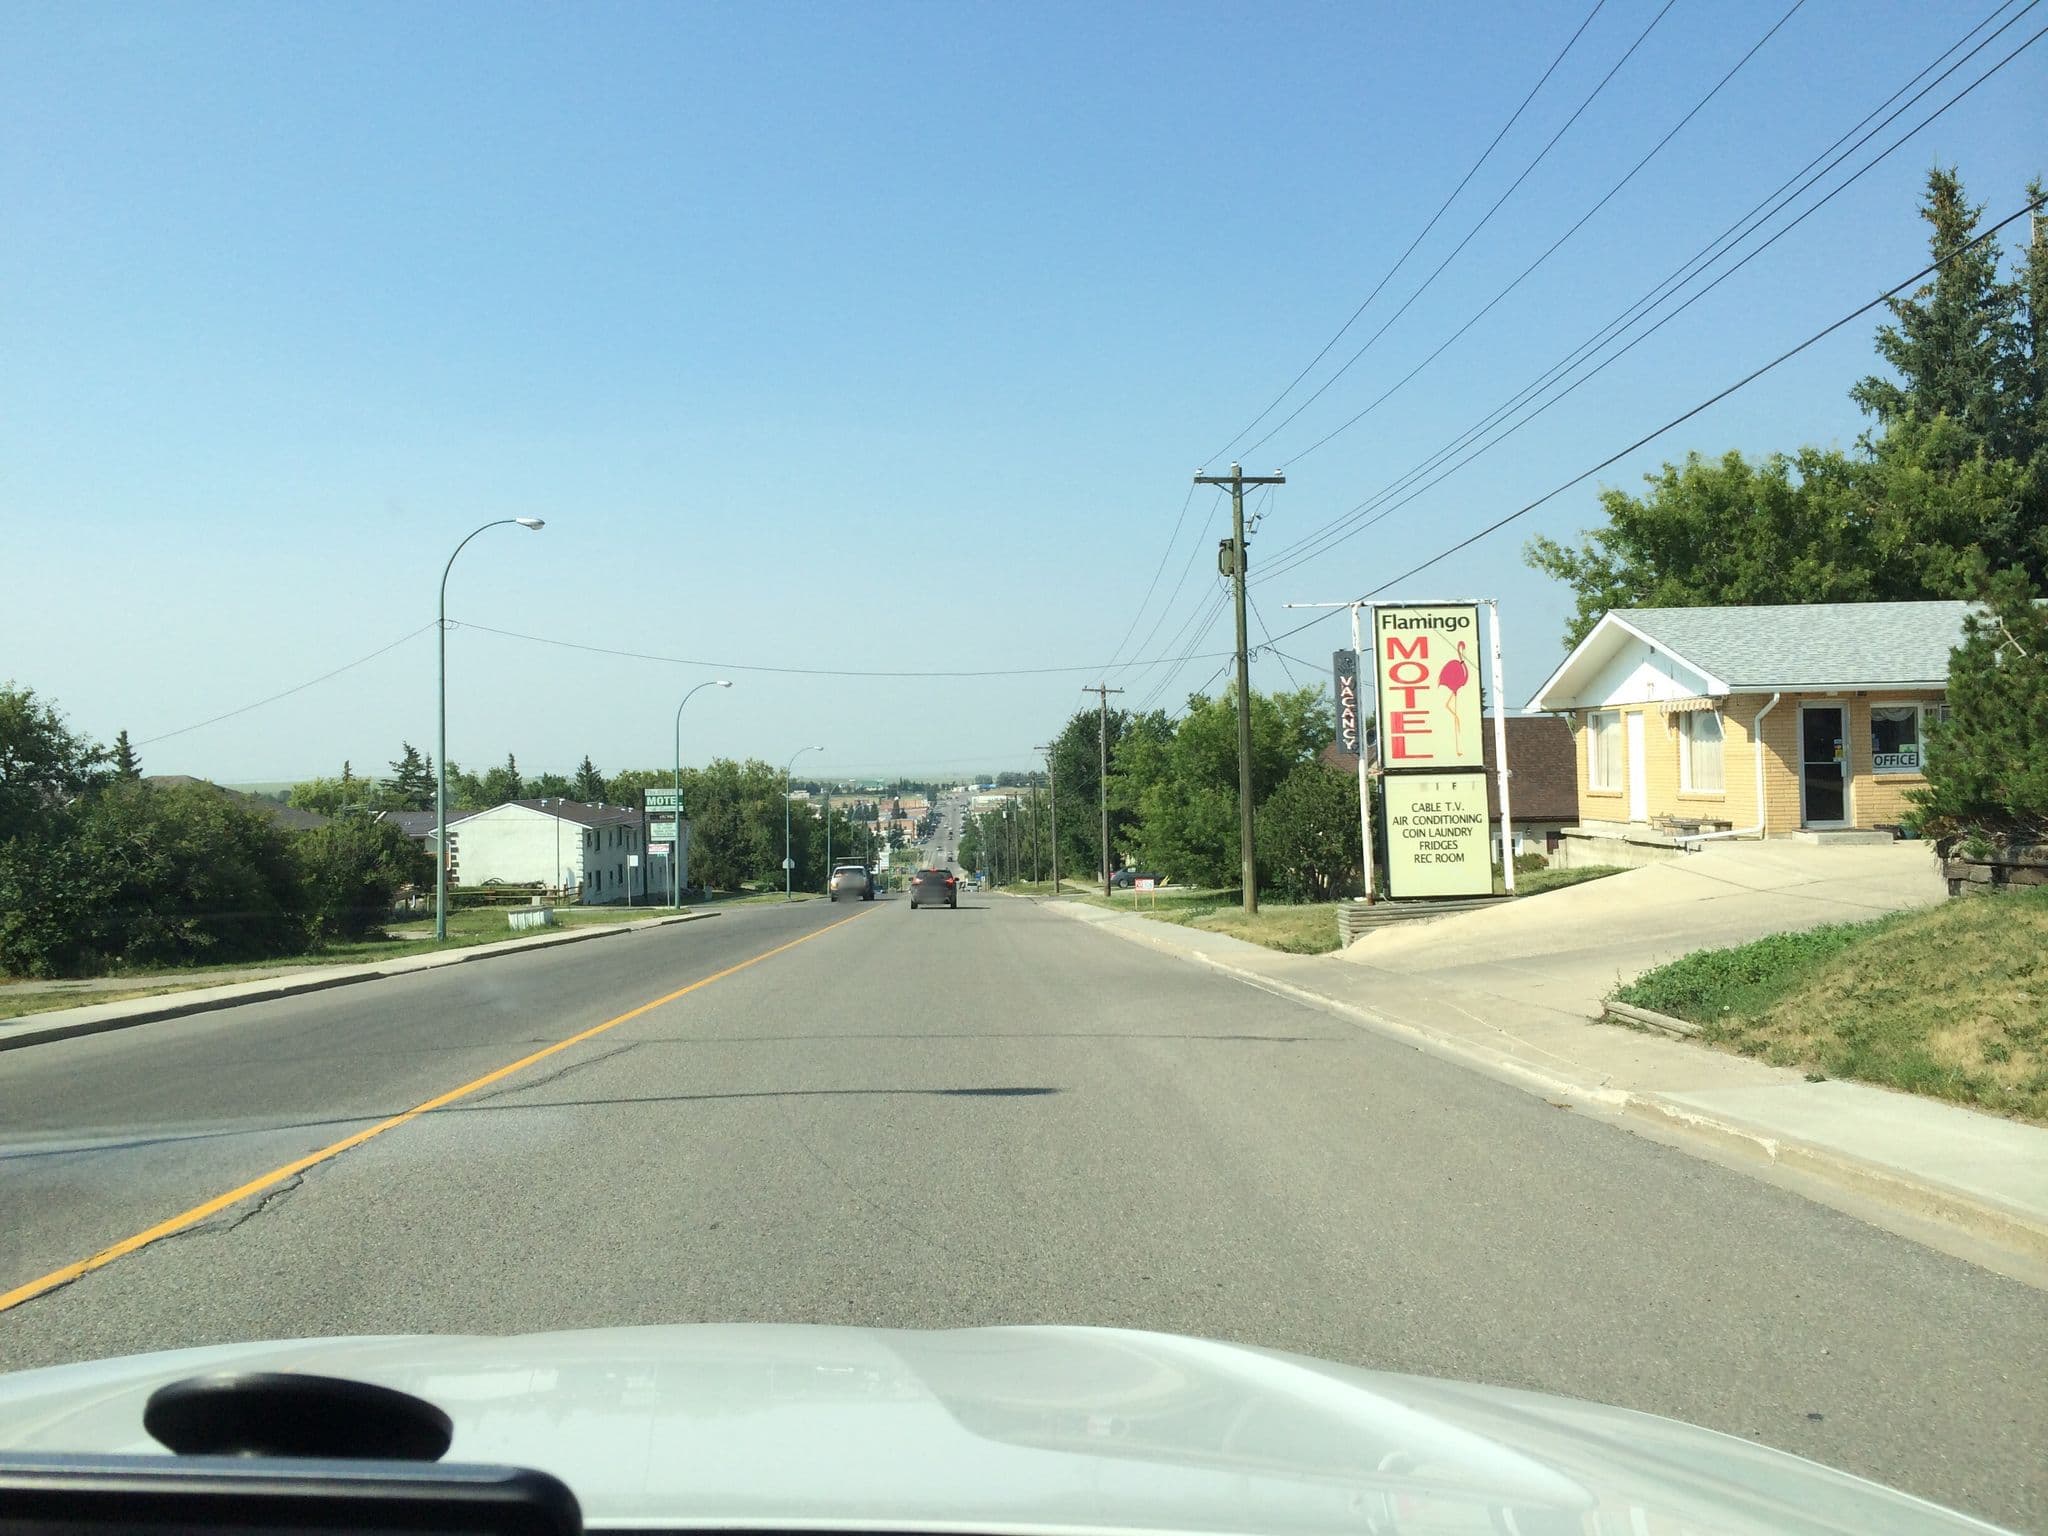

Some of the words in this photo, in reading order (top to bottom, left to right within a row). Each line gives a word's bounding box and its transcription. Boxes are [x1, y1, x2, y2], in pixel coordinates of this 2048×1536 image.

[1382, 613, 1470, 632] Flamingo
[1386, 636, 1433, 759] MOTEL
[1339, 676, 1355, 749] VACANCY
[1874, 754, 1915, 766] OFFICE
[646, 796, 683, 806] MOTE
[1411, 802, 1441, 812] CABLE
[1445, 802, 1465, 811] T.V.
[1392, 816, 1408, 825] AIR
[1412, 813, 1482, 825] CONDITIONING
[1402, 828, 1425, 838] COIN
[1429, 827, 1473, 837] LAUNDRY
[1419, 840, 1458, 850] FRIDGES
[1414, 854, 1432, 863] REC
[1435, 853, 1464, 863] ROOM
